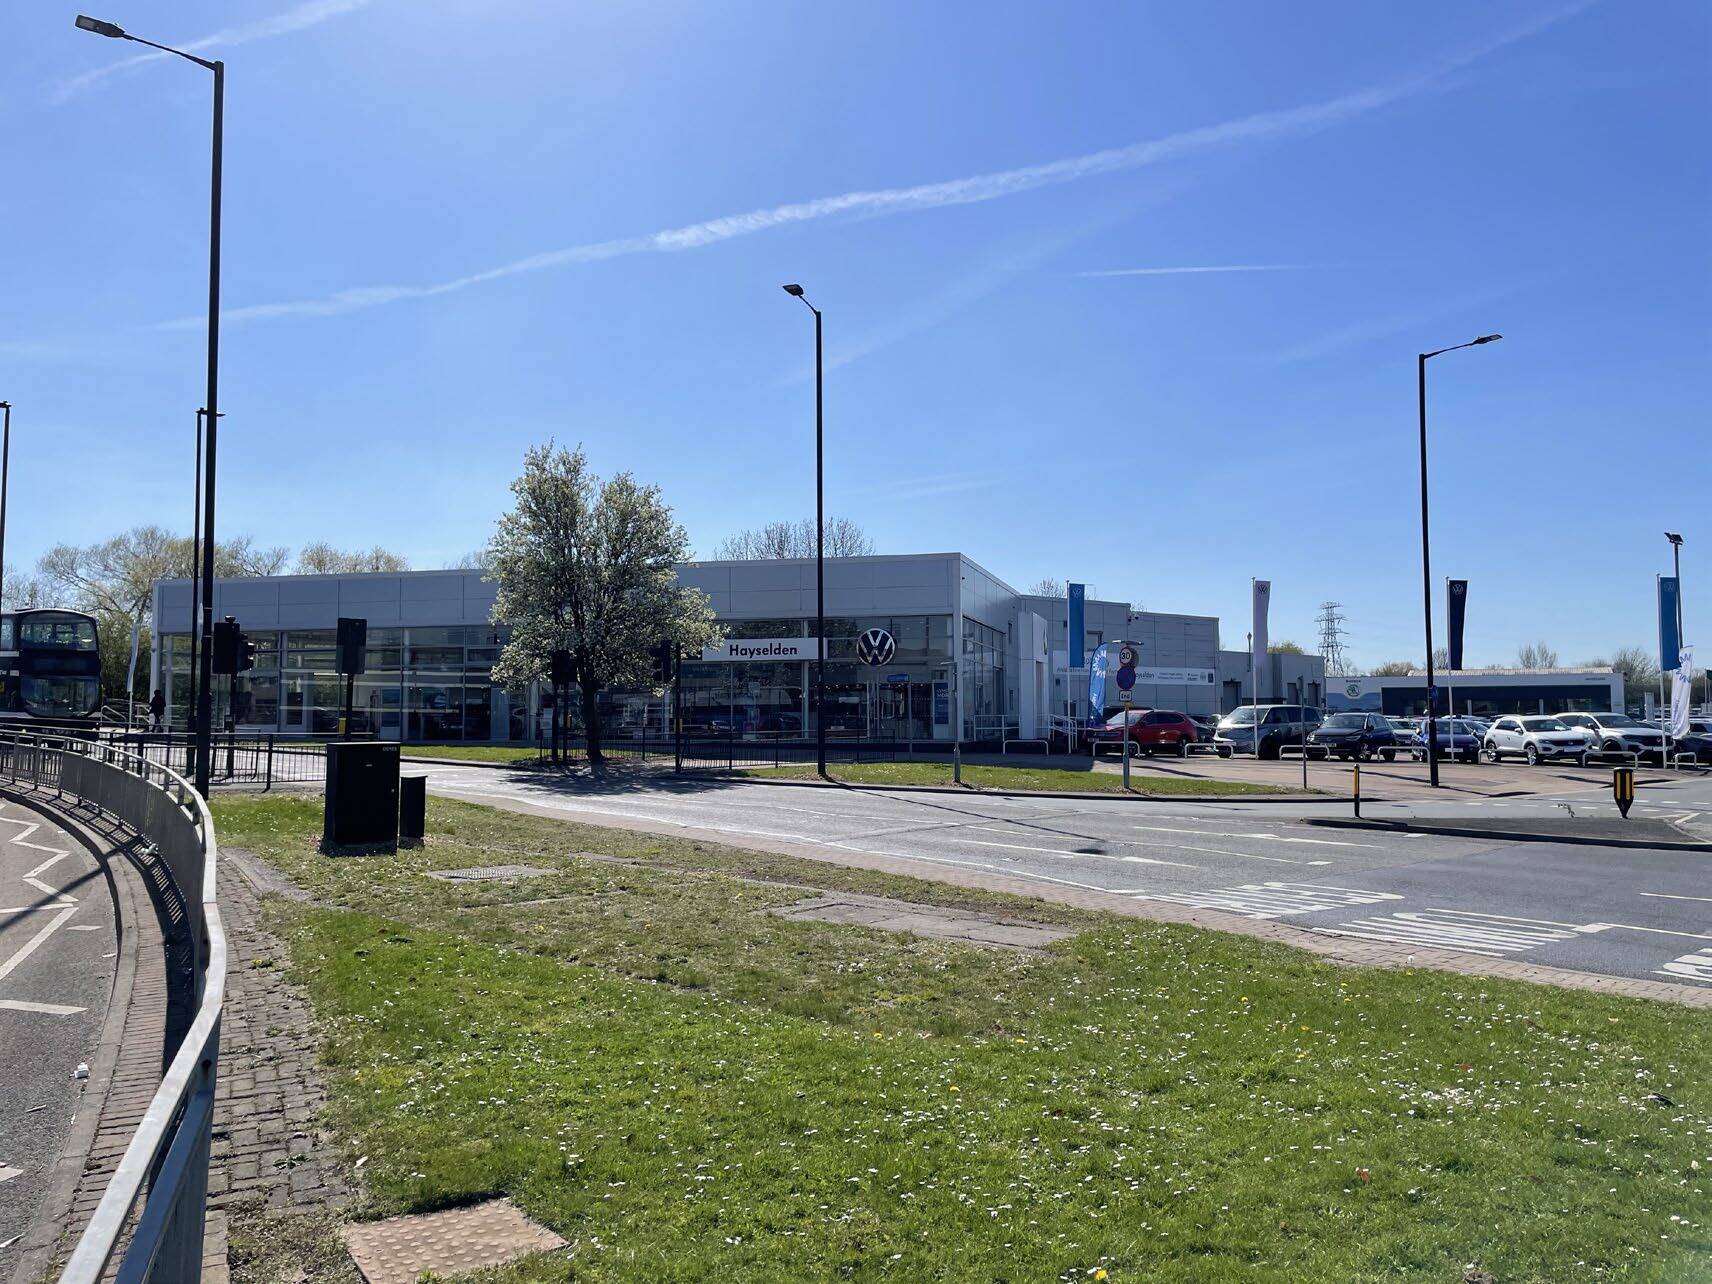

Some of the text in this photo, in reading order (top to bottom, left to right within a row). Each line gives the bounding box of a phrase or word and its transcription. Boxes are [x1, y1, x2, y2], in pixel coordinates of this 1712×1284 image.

[729, 643, 798, 659] Hayselden
[857, 628, 895, 666] VW
[1121, 651, 1131, 660] 30
